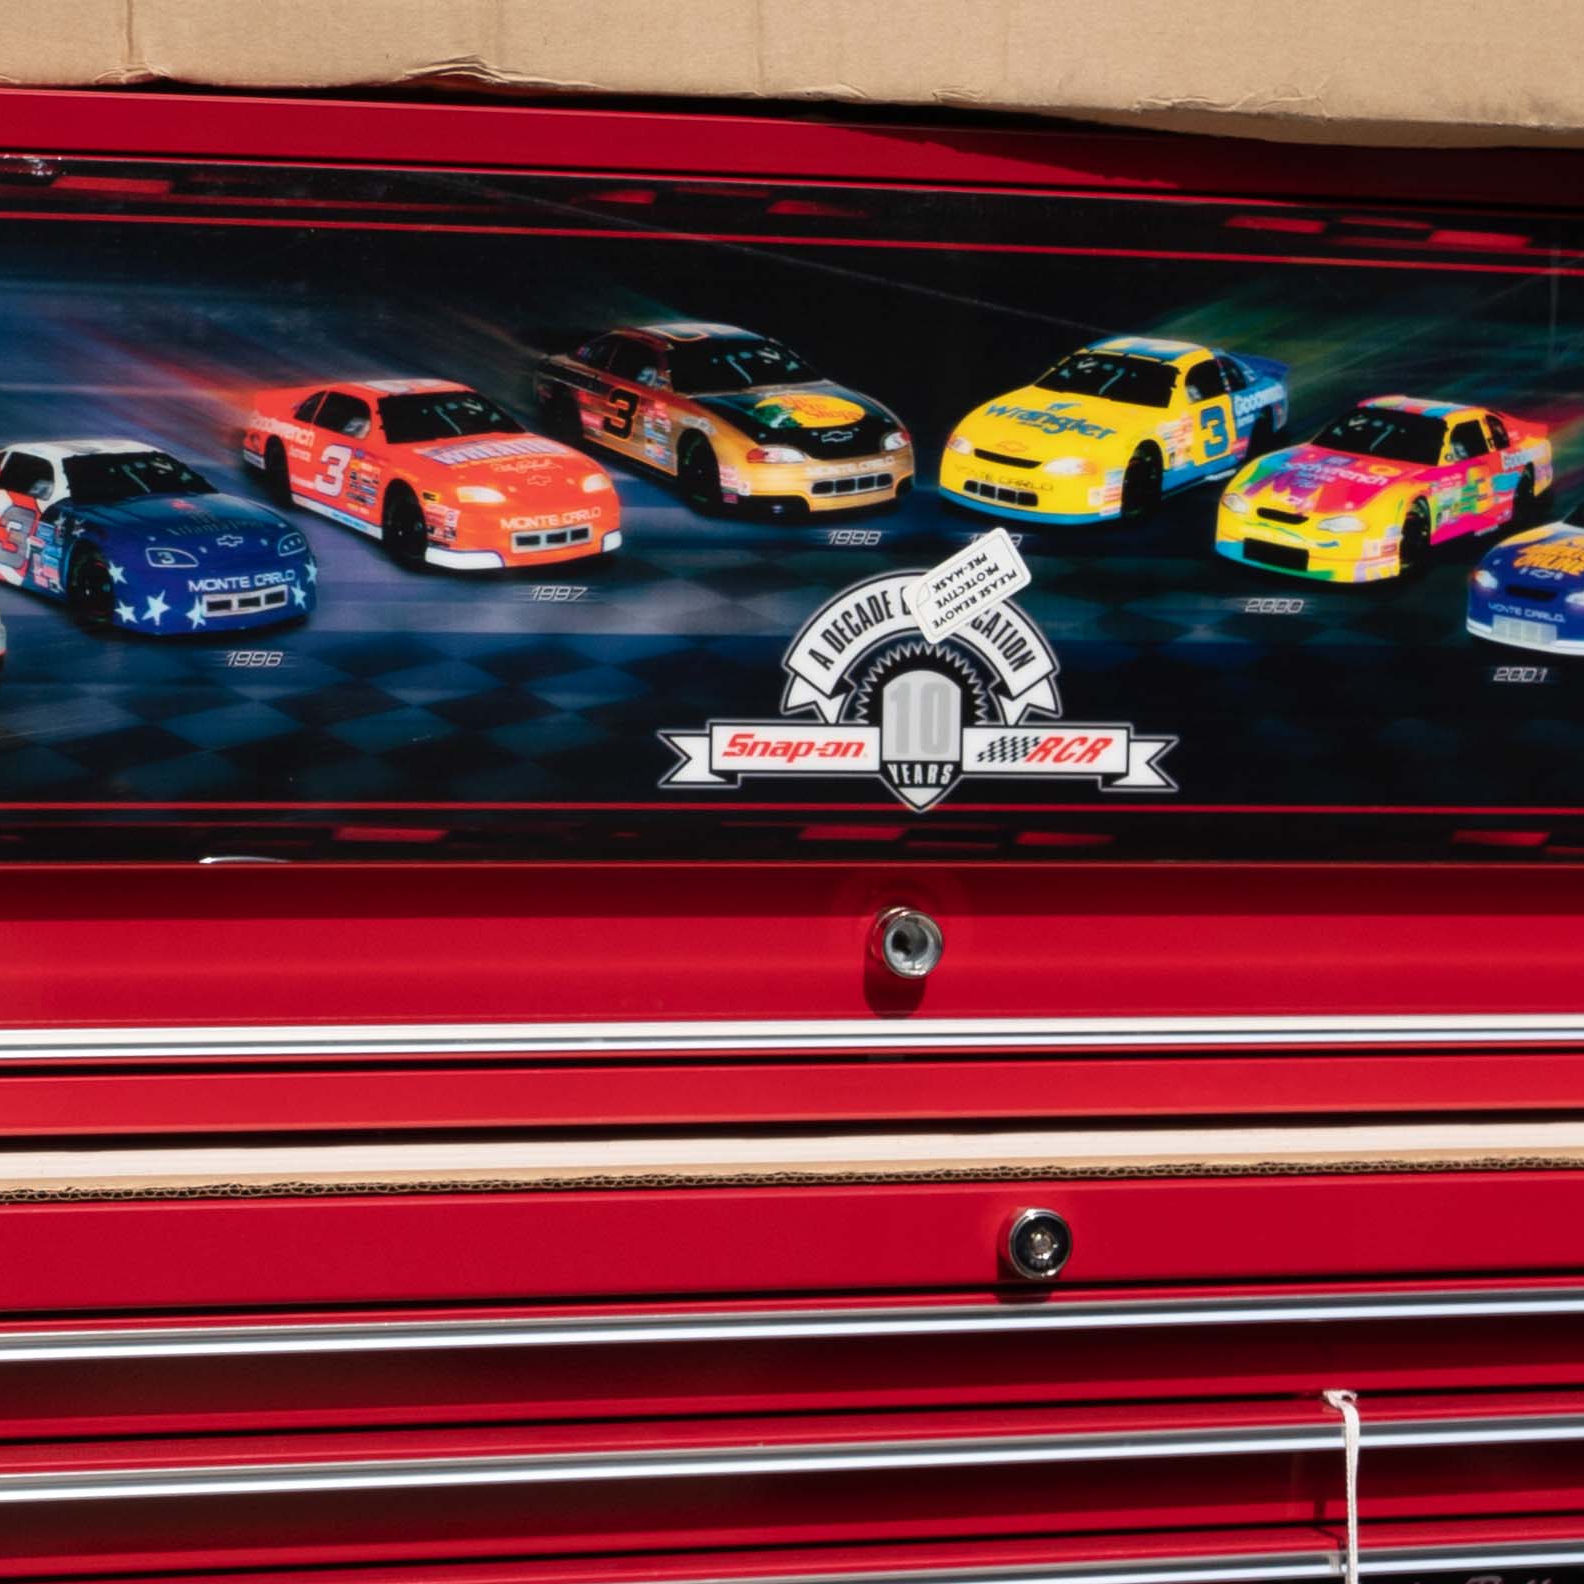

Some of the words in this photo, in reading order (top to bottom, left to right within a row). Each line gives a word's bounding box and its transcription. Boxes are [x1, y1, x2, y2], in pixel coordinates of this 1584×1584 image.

[603, 385, 642, 441] 3
[985, 404, 1118, 440] Wrangler
[1200, 405, 1229, 458] 3
[313, 443, 353, 498] 3
[500, 514, 559, 530] MONTE
[561, 507, 602, 524] CARLO
[828, 529, 882, 546] 1998
[187, 575, 252, 593] MONTE
[253, 568, 296, 588] CARLO
[931, 552, 989, 594] PRE-MASK
[934, 561, 1000, 610] PROTECTIVE
[979, 568, 1018, 599] PLEASE
[530, 585, 588, 601] 1997
[1244, 599, 1305, 614] 2000
[820, 590, 895, 655] DECADE
[932, 595, 978, 629] REMOVE
[225, 650, 284, 667] 1996
[808, 648, 836, 672] A
[1492, 666, 1550, 683] 2001
[889, 680, 952, 755] 10
[1027, 735, 1114, 765] RCR
[890, 761, 952, 787] YEARS
